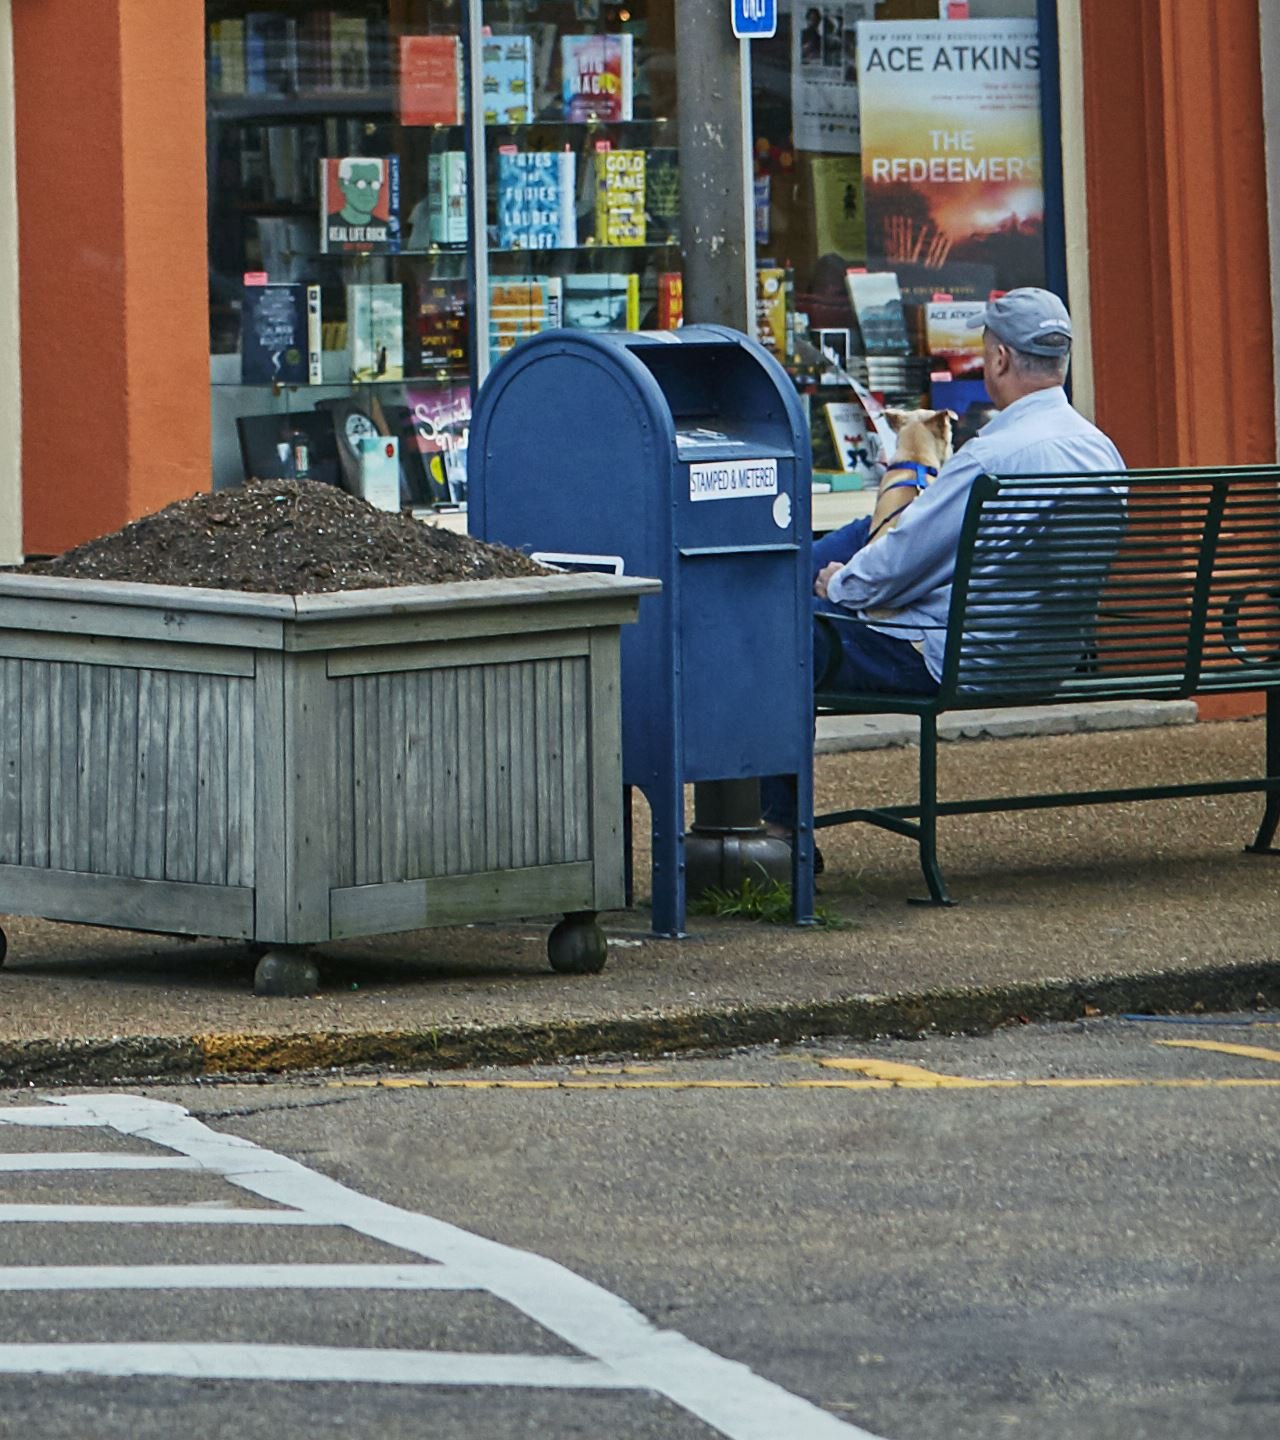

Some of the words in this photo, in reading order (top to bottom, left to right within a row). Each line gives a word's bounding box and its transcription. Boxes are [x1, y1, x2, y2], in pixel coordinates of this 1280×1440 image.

[866, 46, 923, 73] ACE
[932, 45, 1041, 73] ATKINS
[929, 129, 976, 152] THE
[871, 155, 1040, 184] REDEEMERS
[329, 226, 348, 242] REAL
[348, 226, 365, 242] LIFE
[690, 470, 729, 493] STAMPED
[730, 469, 738, 490] &
[740, 466, 776, 489] METERED
